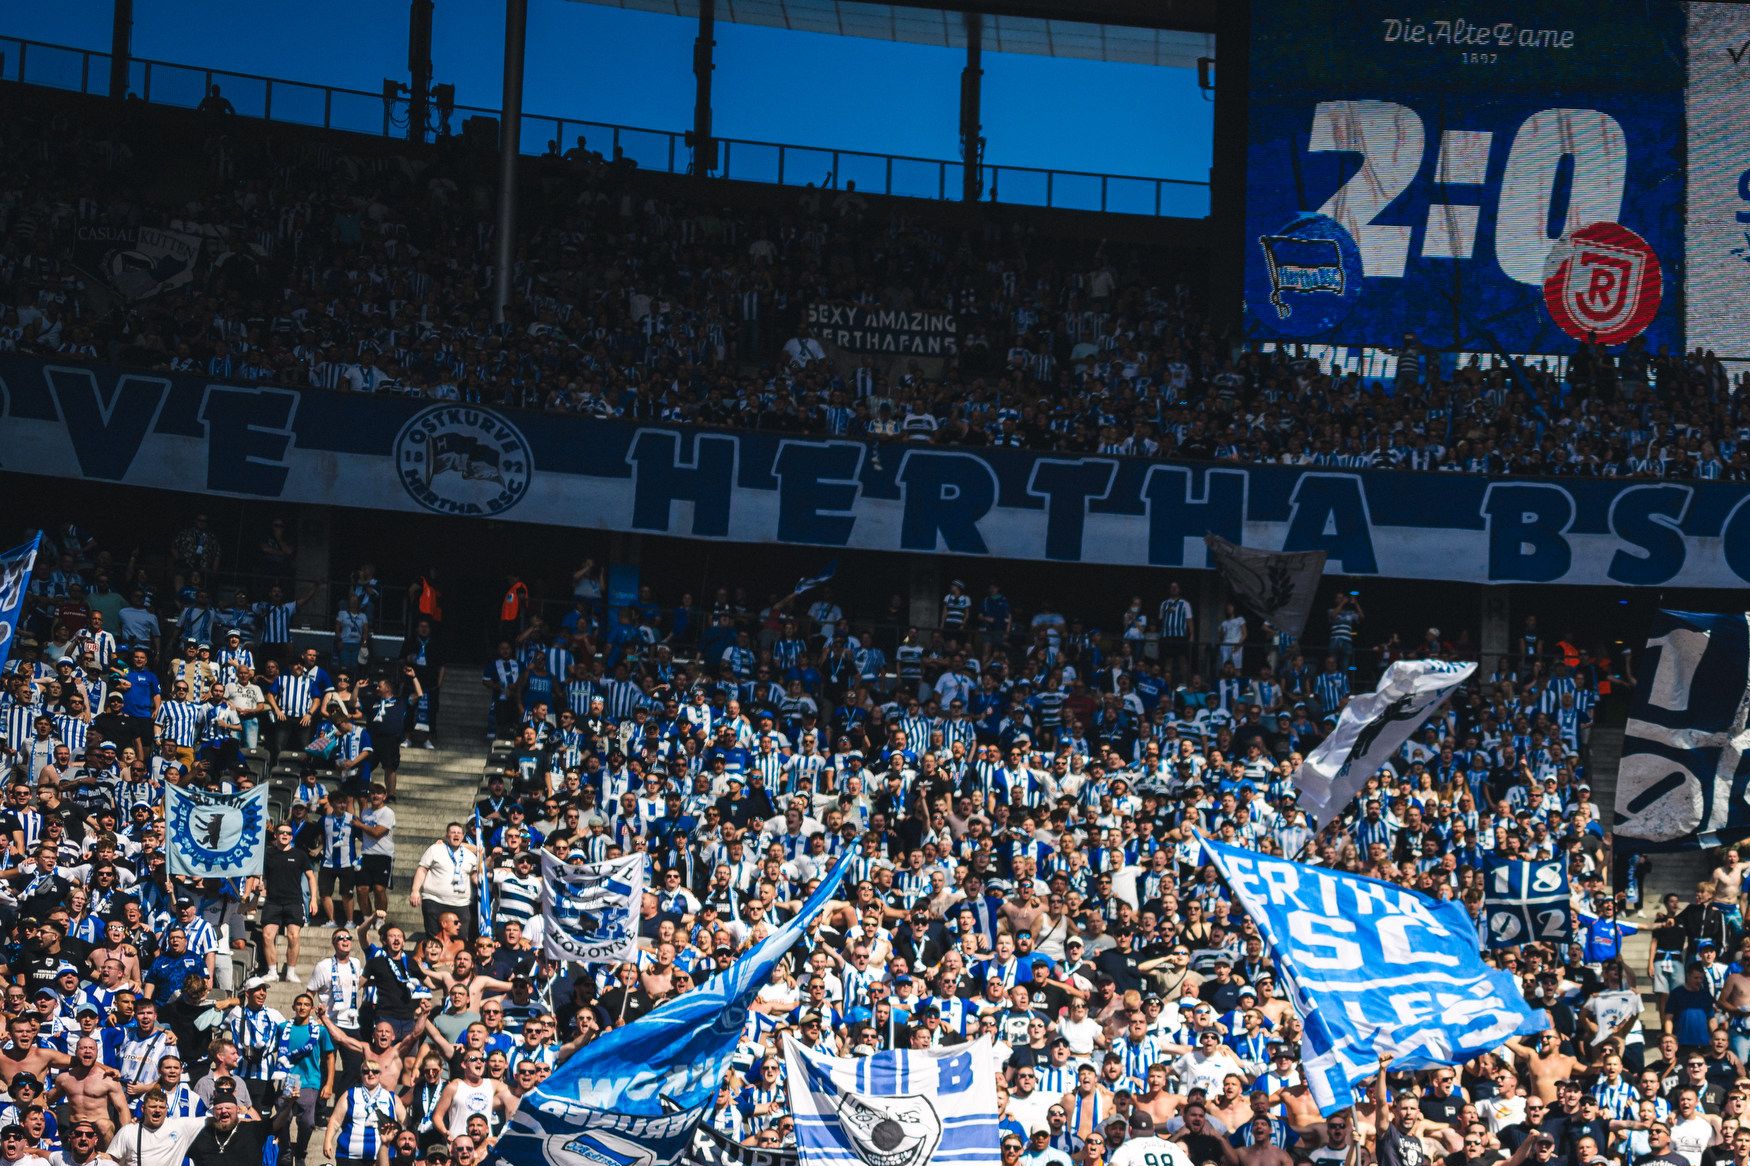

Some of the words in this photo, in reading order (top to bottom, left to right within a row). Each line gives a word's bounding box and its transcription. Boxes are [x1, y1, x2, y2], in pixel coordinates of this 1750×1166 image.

[1381, 17, 1426, 43] Die
[78, 224, 138, 242] CASUAL
[140, 229, 194, 260] KUTTEN
[808, 303, 858, 325] SEXY
[864, 309, 957, 333] AMAZING
[0, 366, 300, 497] VE
[408, 409, 522, 454] OSTKURVE
[404, 450, 424, 463] 18
[502, 459, 524, 474] 92
[404, 468, 483, 514] HERTHA
[486, 478, 524, 512] BSC
[627, 428, 1379, 576] HERTHA
[552, 864, 634, 881] HAVEL
[1222, 854, 1453, 938] ERTHA
[549, 927, 636, 959] KOLONNE
[1286, 910, 1461, 971] SC
